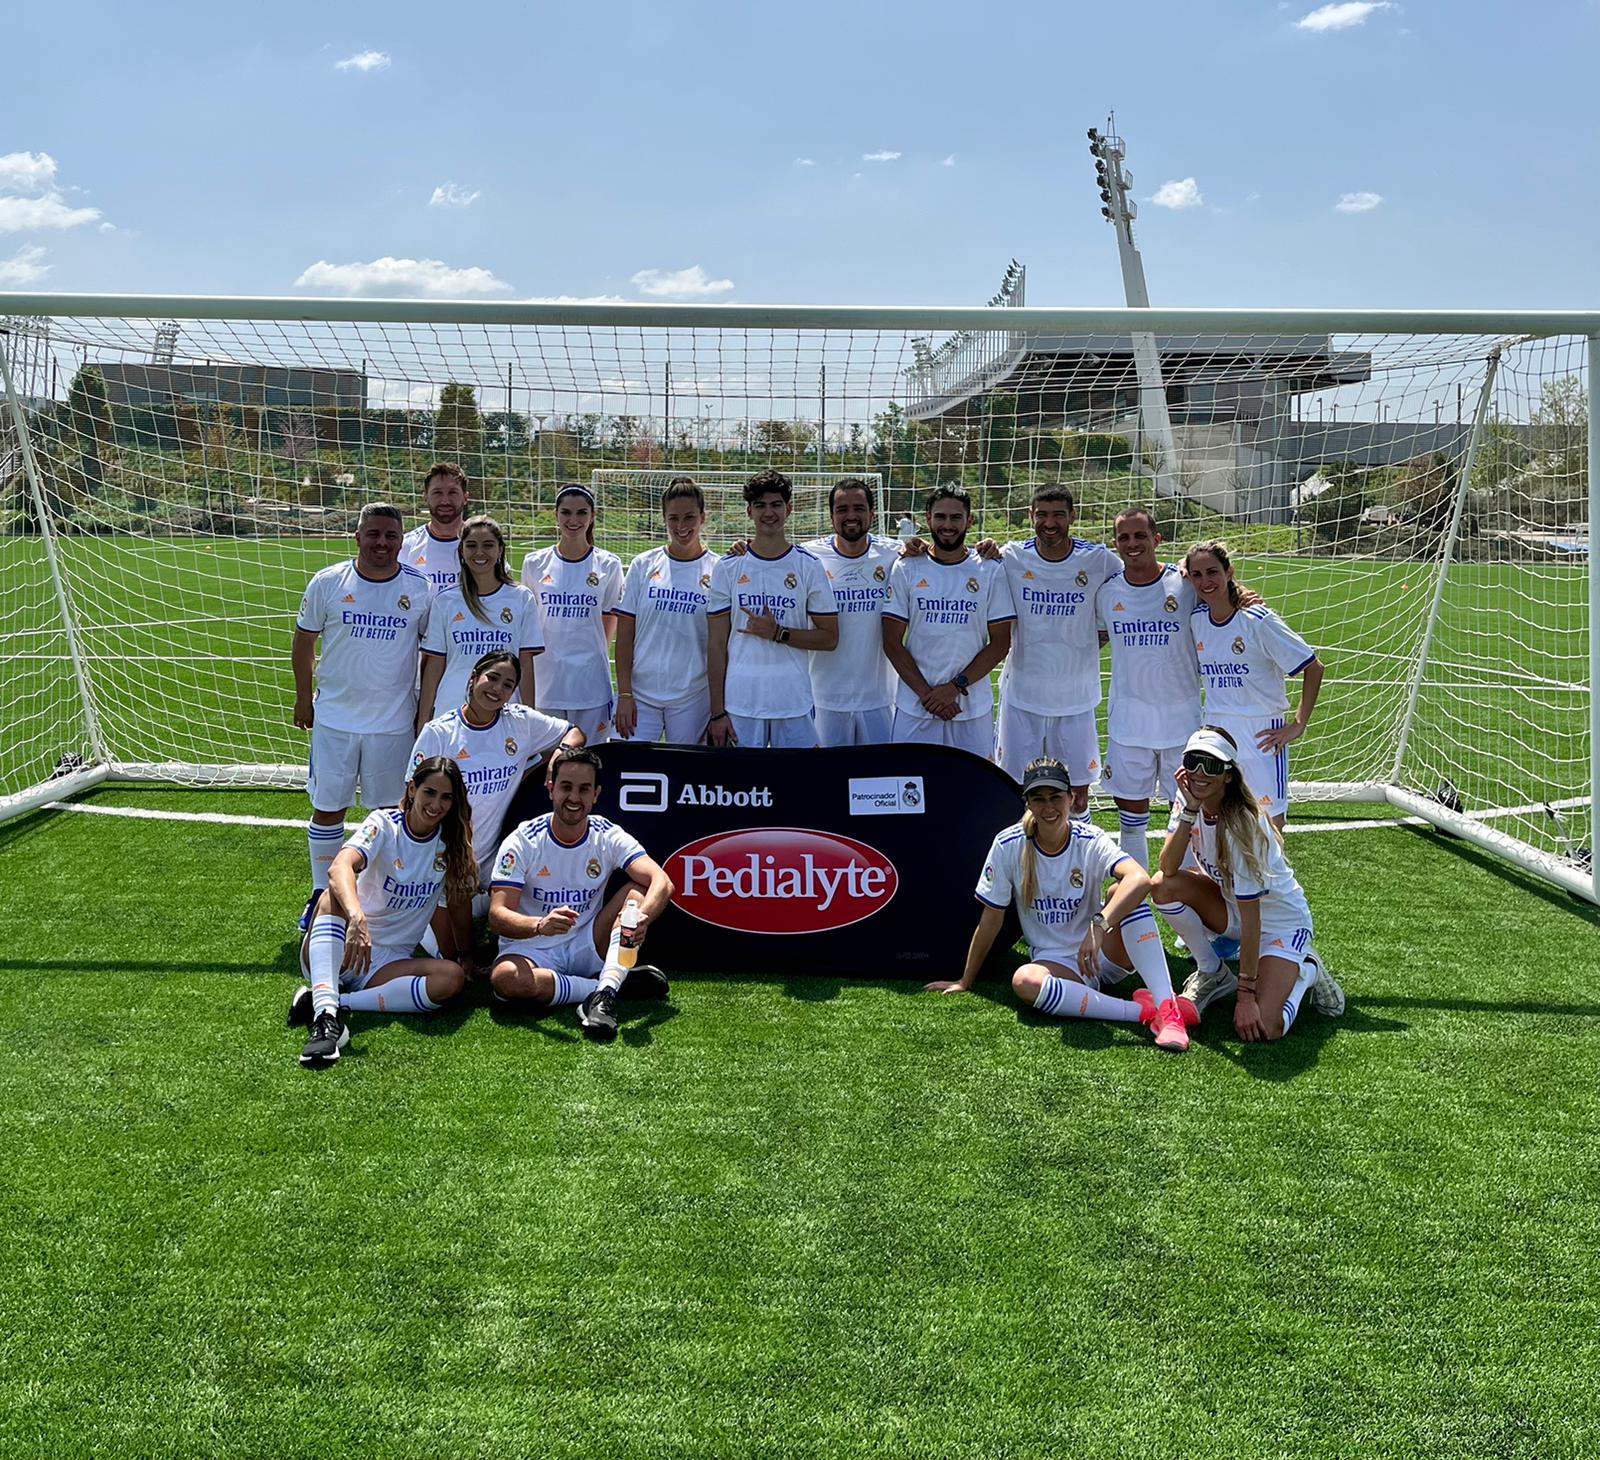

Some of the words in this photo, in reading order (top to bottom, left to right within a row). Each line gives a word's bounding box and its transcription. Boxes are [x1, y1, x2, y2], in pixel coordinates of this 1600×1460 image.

[541, 592, 598, 606] Emirates
[648, 586, 708, 605] Emirates
[738, 592, 796, 609] Emirates
[833, 587, 885, 601] mirates
[1022, 587, 1085, 604] Emirates
[547, 606, 560, 617] FLY
[562, 607, 590, 618] BETTER
[655, 600, 668, 611] FLY
[668, 601, 697, 615] BETTER
[848, 601, 876, 613] BETTER
[917, 597, 978, 612] Emirates
[1030, 603, 1044, 614] FLY
[1046, 604, 1076, 616] BETTER
[342, 611, 408, 628] Emirates
[926, 612, 939, 624] FLY
[941, 613, 969, 625] BETTER
[1113, 618, 1180, 634] Emirates
[350, 626, 365, 638] FLY
[366, 627, 397, 641] BETTER
[452, 628, 512, 645] Emirates
[1124, 635, 1136, 647] FLY
[1139, 634, 1169, 647] BETTER
[676, 783, 773, 807] Abbott
[852, 792, 896, 800] Patrocinador
[383, 875, 440, 897] Emirate
[533, 887, 600, 903] Emirate
[1030, 895, 1084, 911] mirate
